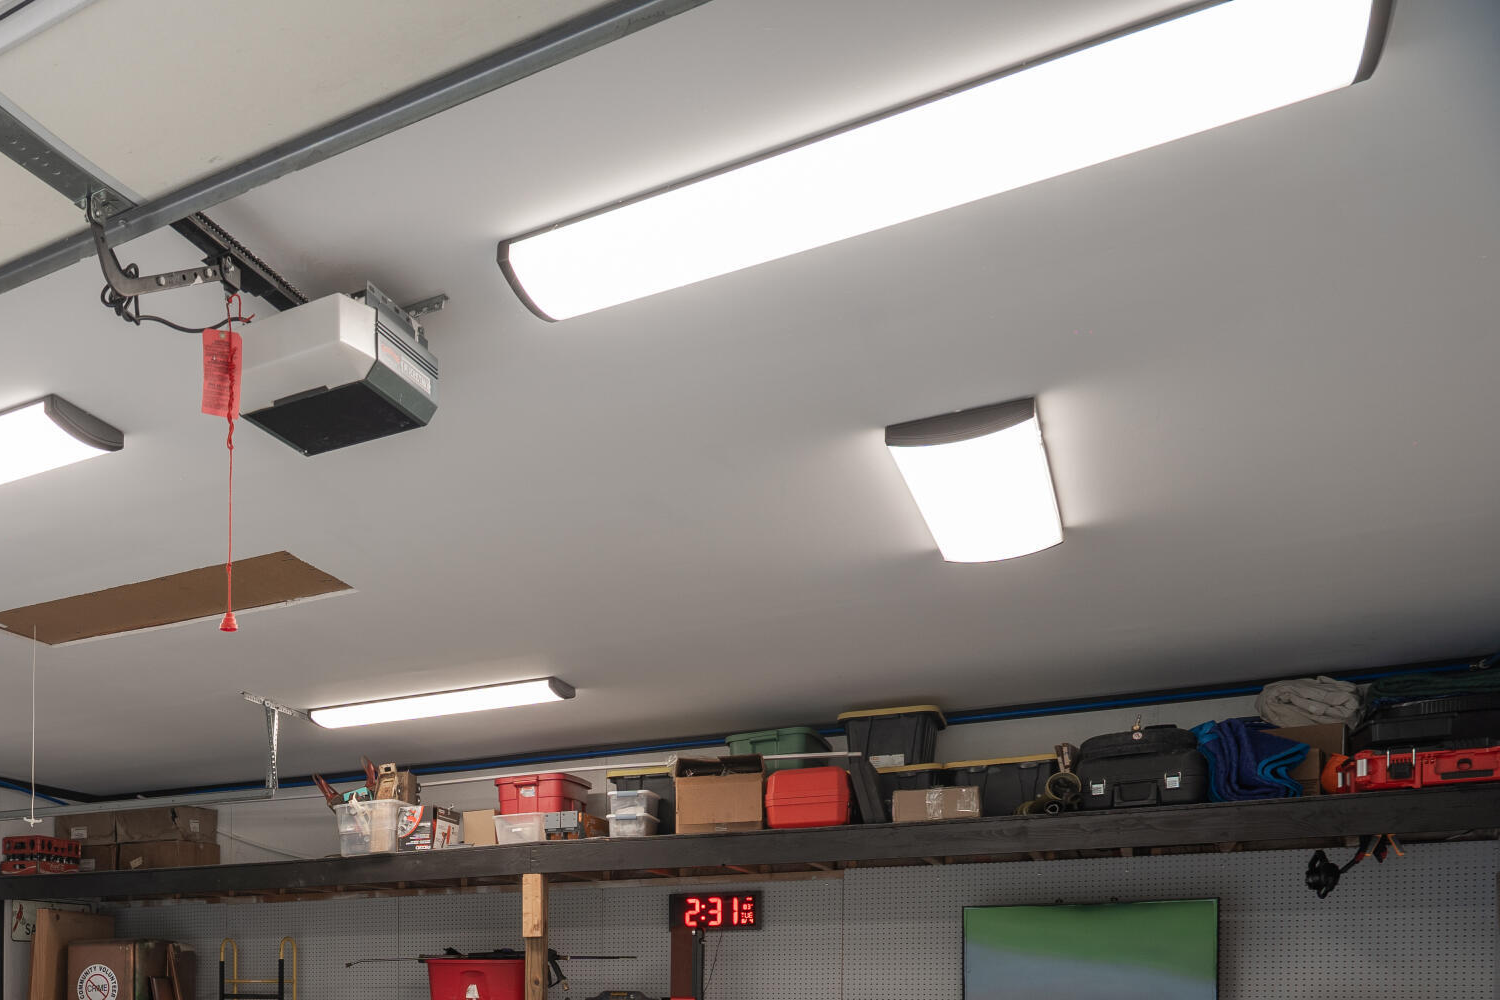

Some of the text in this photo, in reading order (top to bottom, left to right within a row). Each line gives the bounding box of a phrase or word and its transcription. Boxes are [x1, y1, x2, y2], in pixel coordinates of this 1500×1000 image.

[684, 896, 739, 927] 2:31
[78, 966, 117, 1000] COMMUNITY VOLUNTEER
